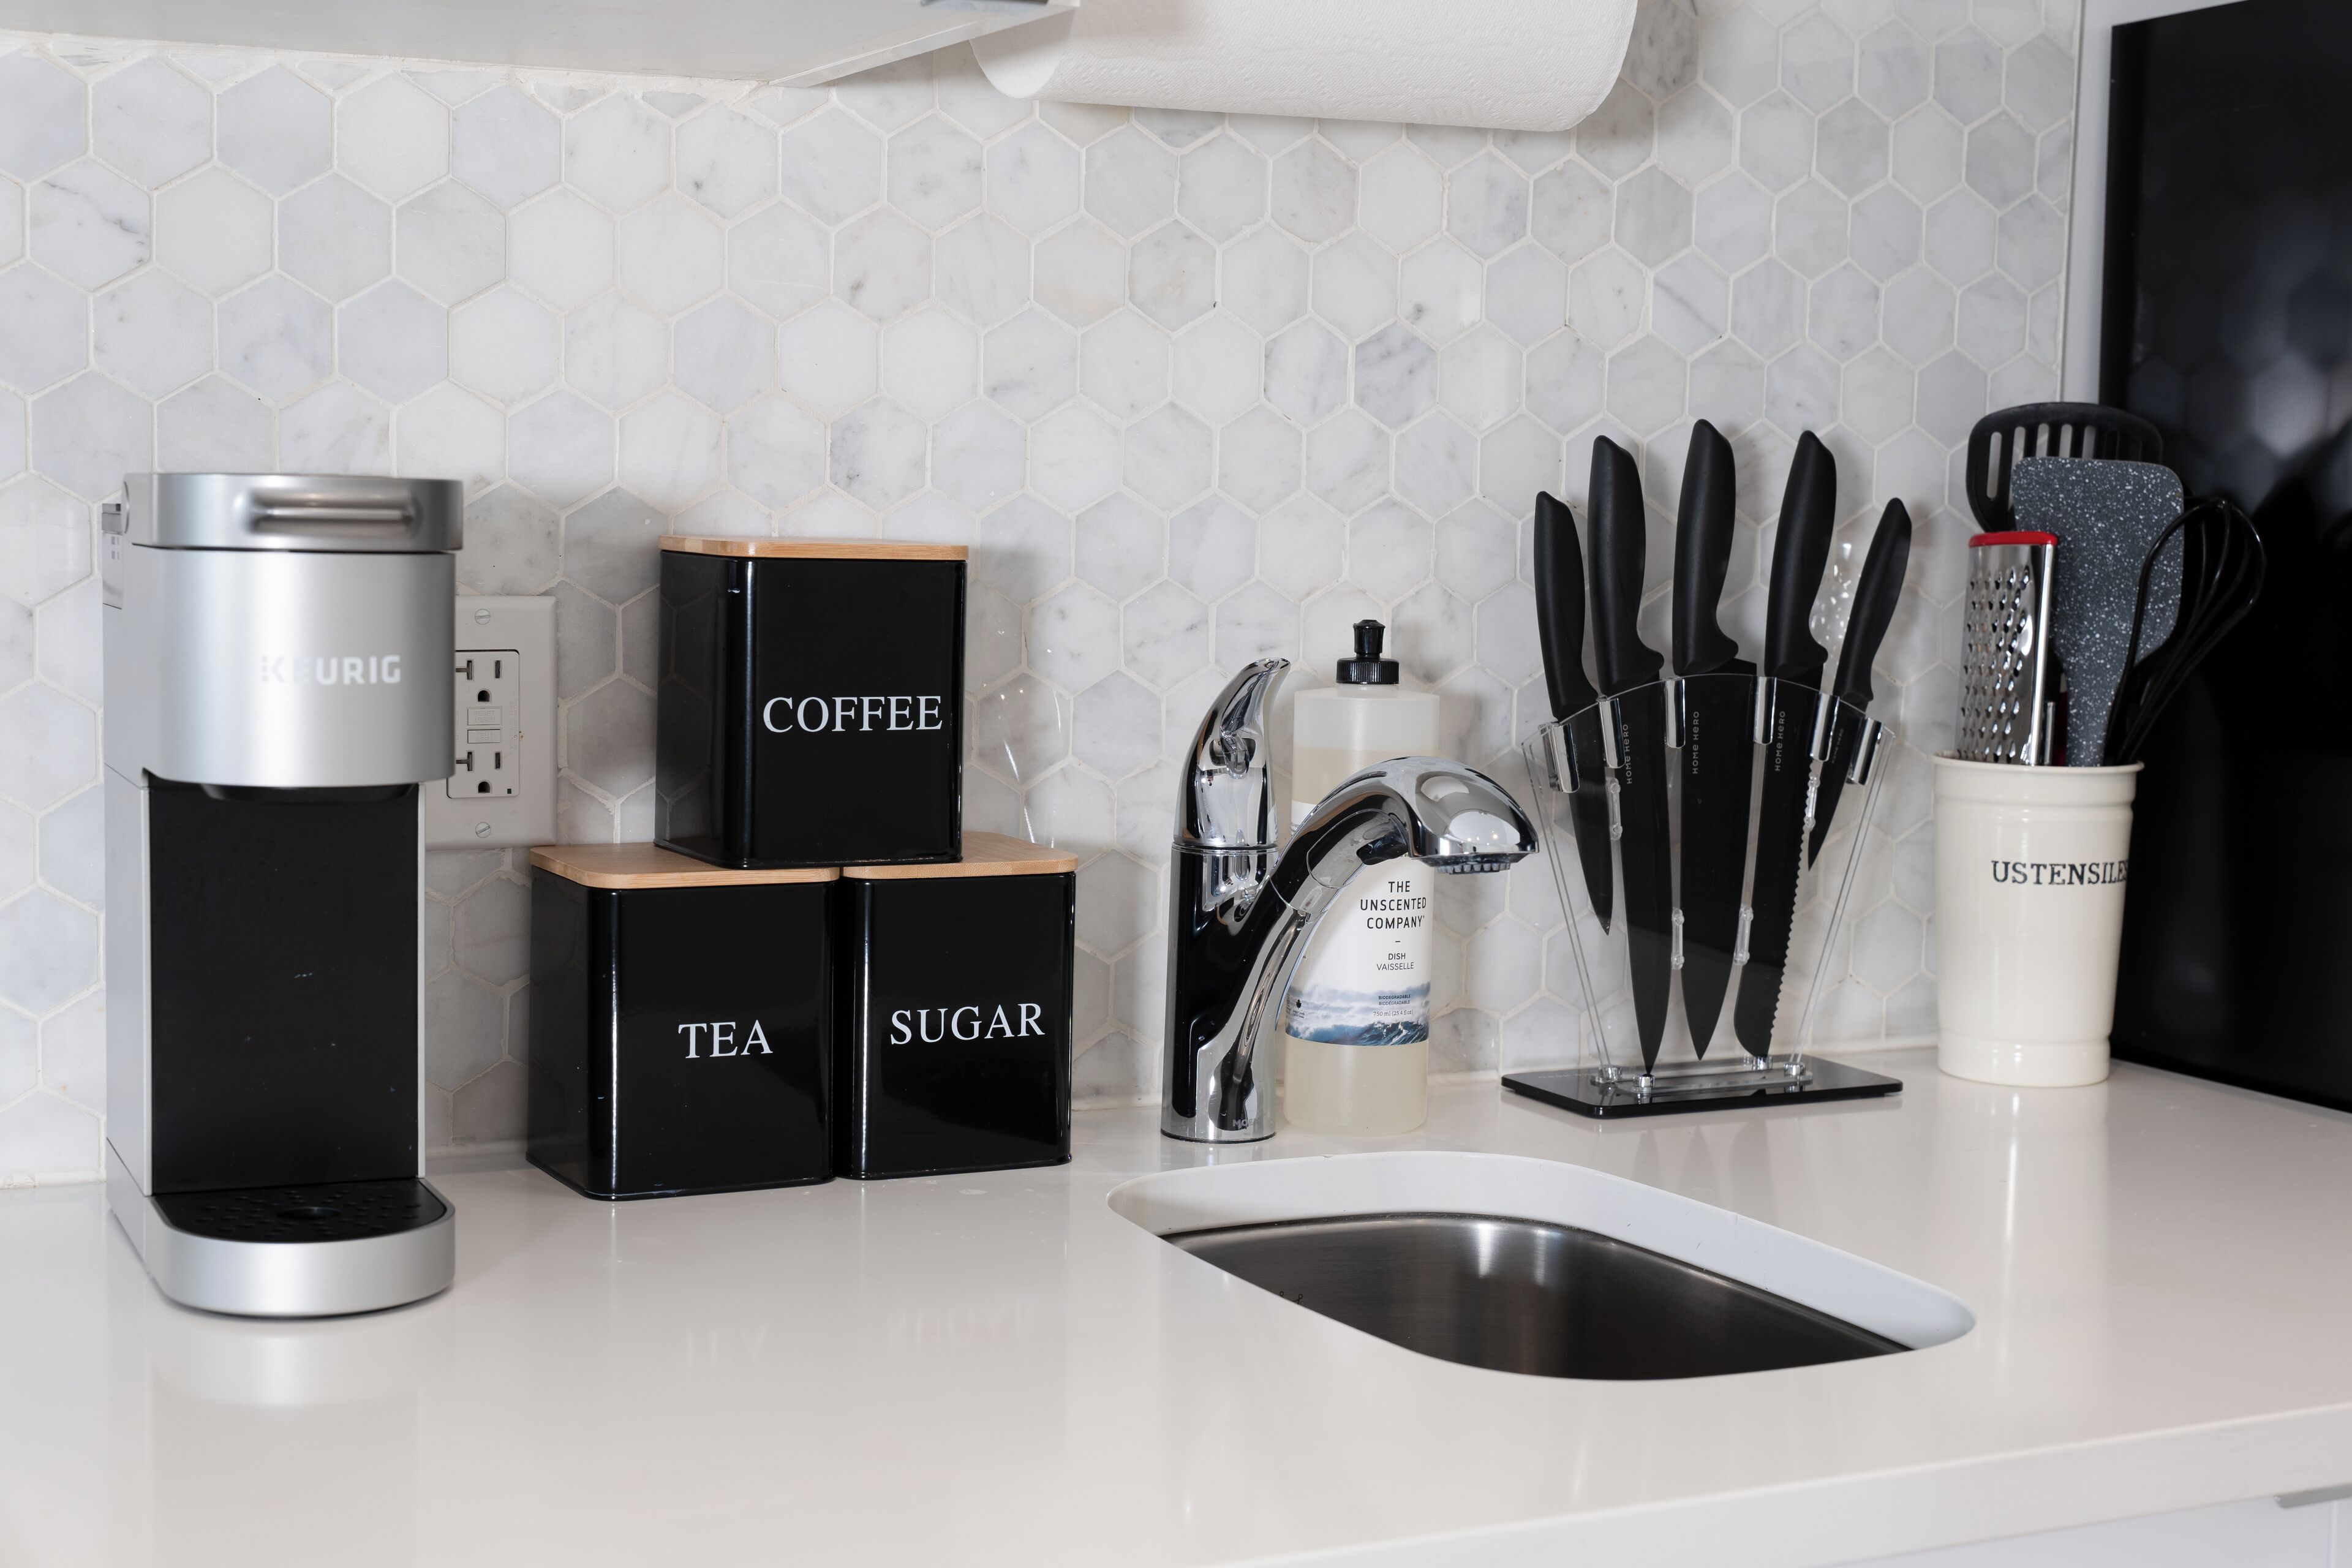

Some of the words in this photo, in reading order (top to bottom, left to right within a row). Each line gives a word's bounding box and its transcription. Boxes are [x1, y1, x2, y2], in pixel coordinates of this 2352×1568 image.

[261, 655, 401, 685] KEURIG
[763, 695, 943, 733] COFFEE
[1389, 881, 1411, 892] THE
[1360, 897, 1427, 911] UNSCENTED
[1367, 916, 1422, 929] COMPANY
[1377, 962, 1414, 971] VAISSELLE
[891, 1003, 1046, 1045] SUGAR
[678, 1019, 773, 1059] TEA
[1232, 1118, 1254, 1128] MOE
